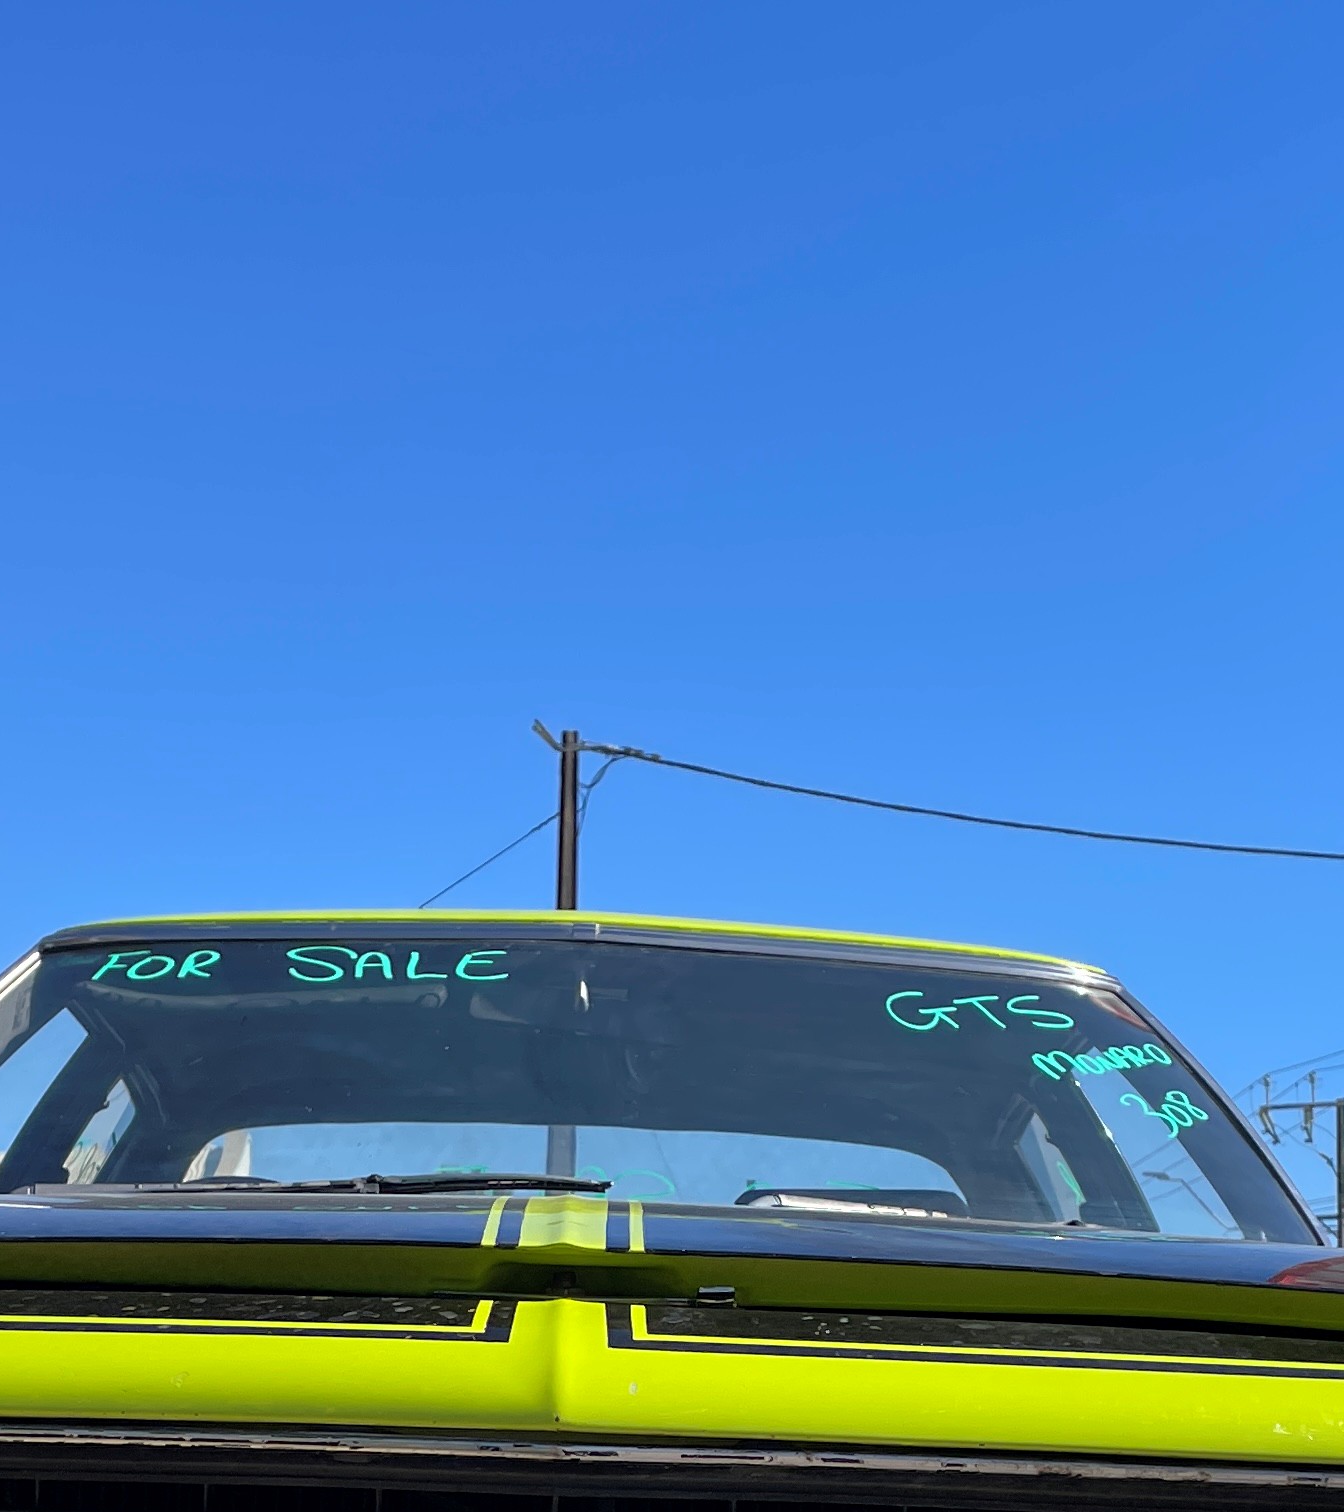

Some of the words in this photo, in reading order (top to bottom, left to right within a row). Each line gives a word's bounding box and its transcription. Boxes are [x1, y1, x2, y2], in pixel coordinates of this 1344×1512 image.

[91, 949, 221, 981] FOR
[286, 945, 509, 982] SALE
[885, 990, 1075, 1031] GTS
[1119, 1089, 1210, 1140] 308
